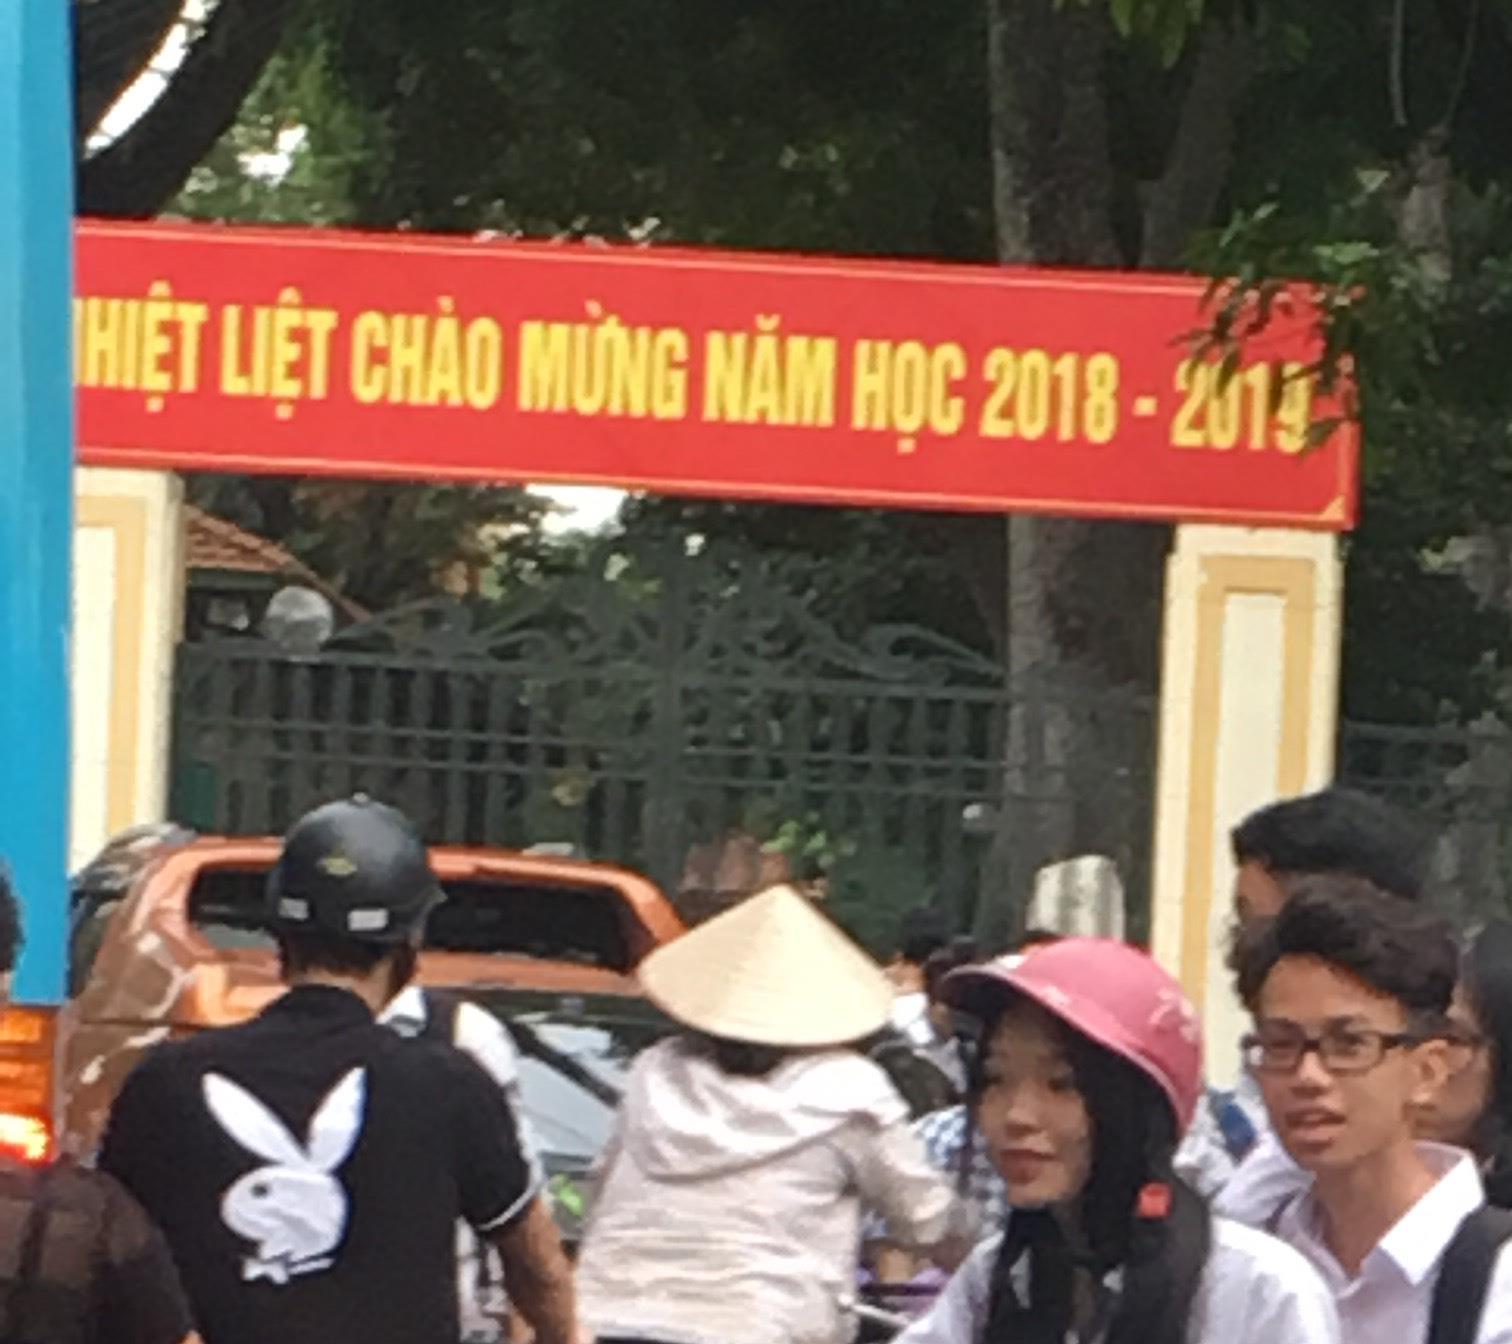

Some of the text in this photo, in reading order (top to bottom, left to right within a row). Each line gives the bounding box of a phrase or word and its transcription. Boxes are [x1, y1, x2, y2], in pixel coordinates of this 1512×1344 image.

[219, 285, 339, 420] LIỆT
[350, 295, 503, 411] CHÀO
[517, 299, 689, 420] MỪNG
[702, 313, 838, 428] NĂM
[850, 339, 967, 453] HỌC
[978, 347, 1119, 444] 2018
